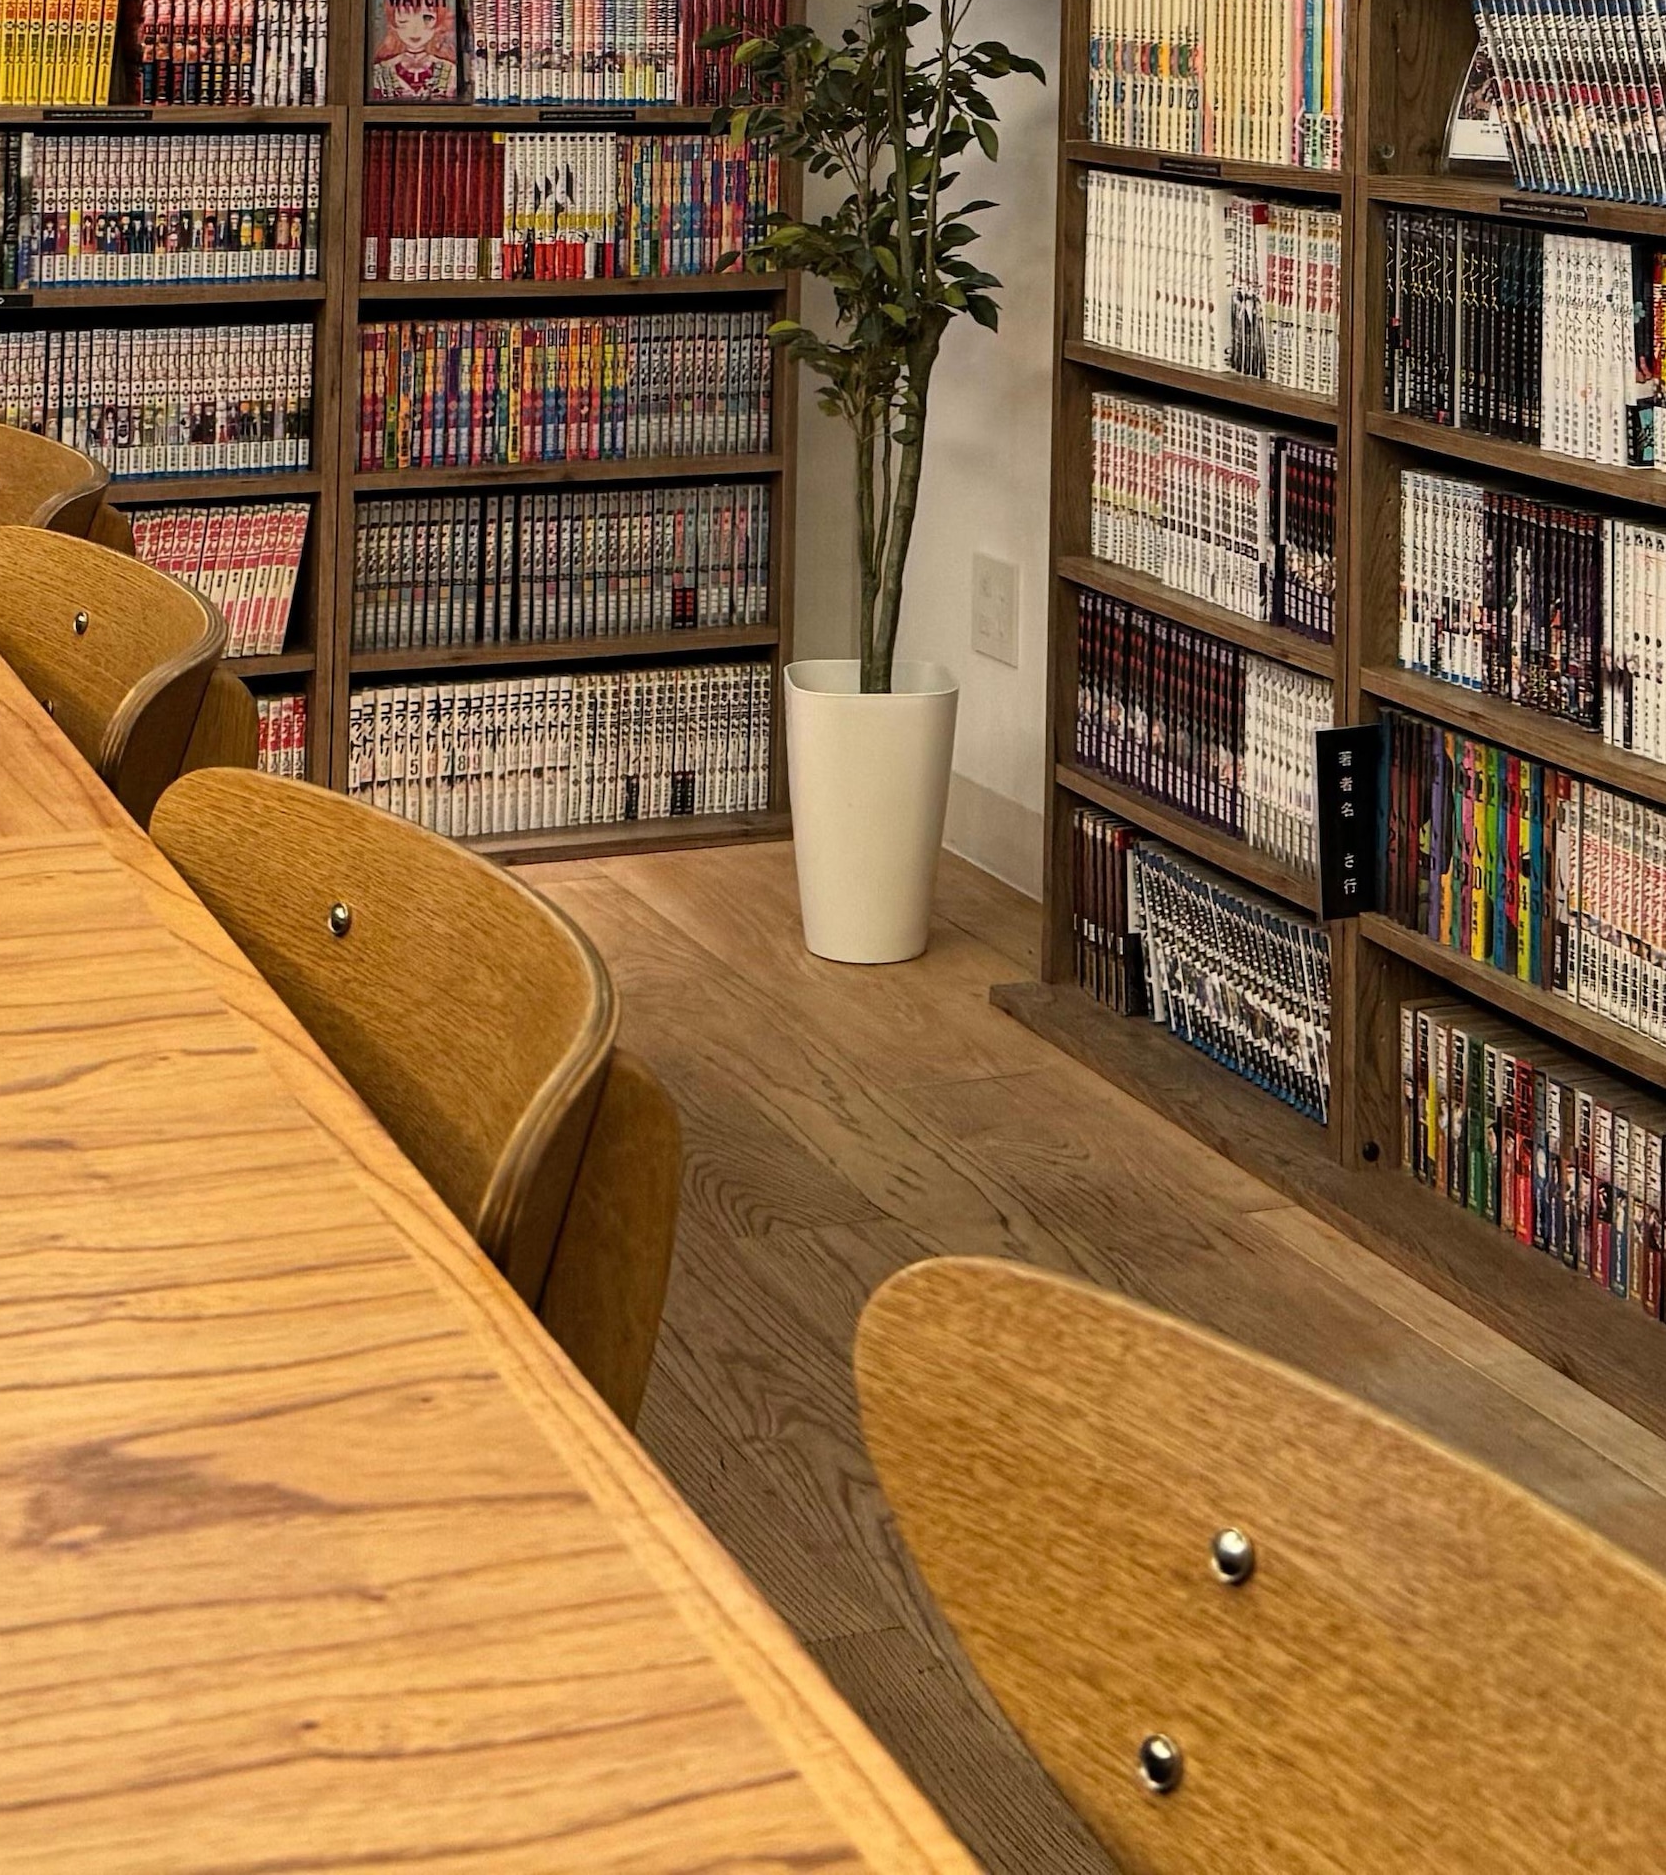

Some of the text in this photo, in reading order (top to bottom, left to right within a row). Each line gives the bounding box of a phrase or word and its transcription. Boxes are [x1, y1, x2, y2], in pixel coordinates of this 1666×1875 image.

[1338, 751, 1357, 895] 著者名 さ行
